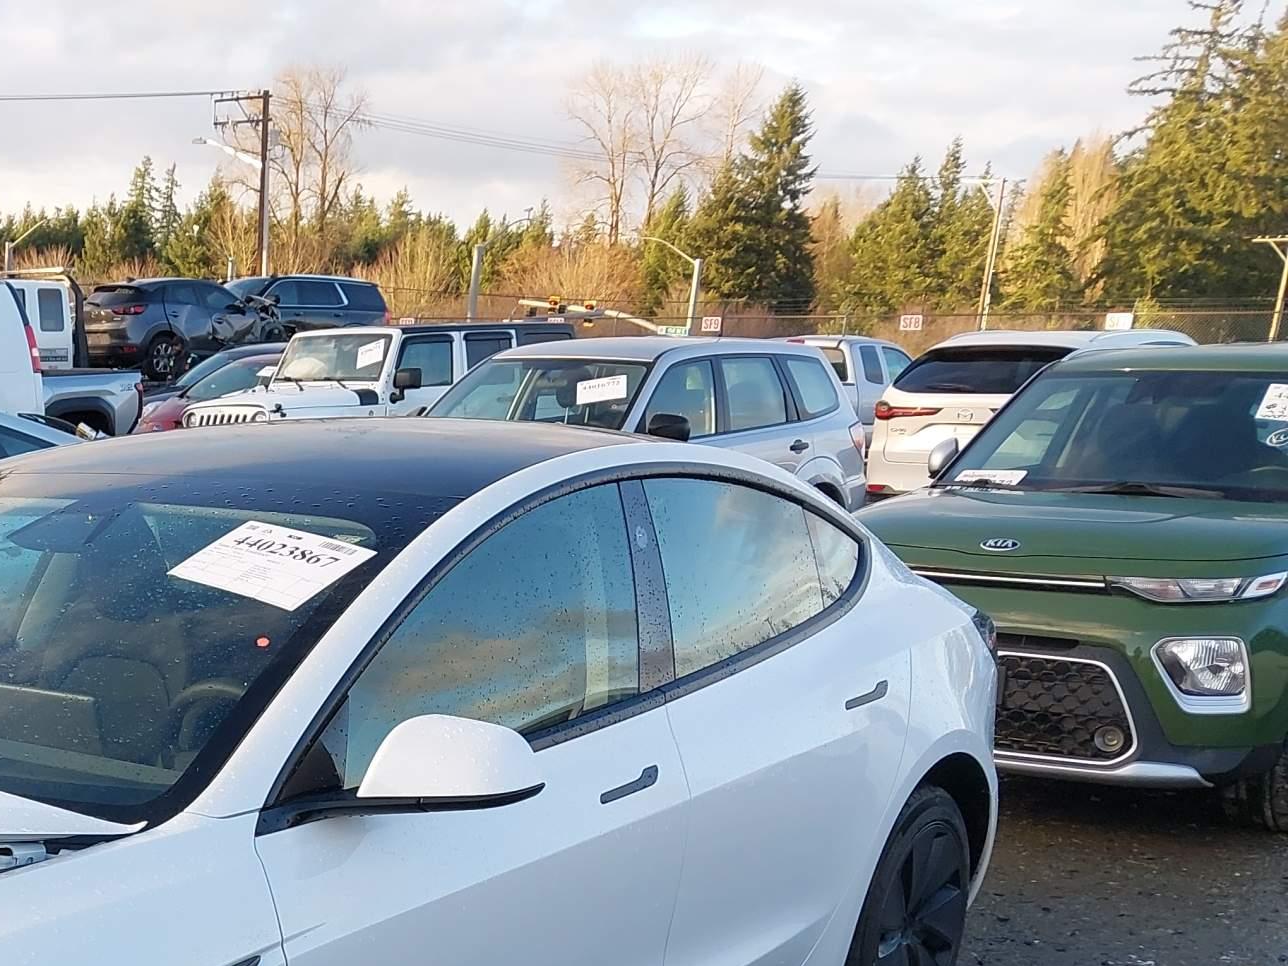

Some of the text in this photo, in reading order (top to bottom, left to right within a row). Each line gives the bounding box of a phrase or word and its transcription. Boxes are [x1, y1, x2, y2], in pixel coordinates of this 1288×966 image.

[703, 318, 720, 329] SF9
[902, 317, 920, 328] SF8
[985, 539, 1013, 548] KIA
[233, 535, 341, 568] 44023867
